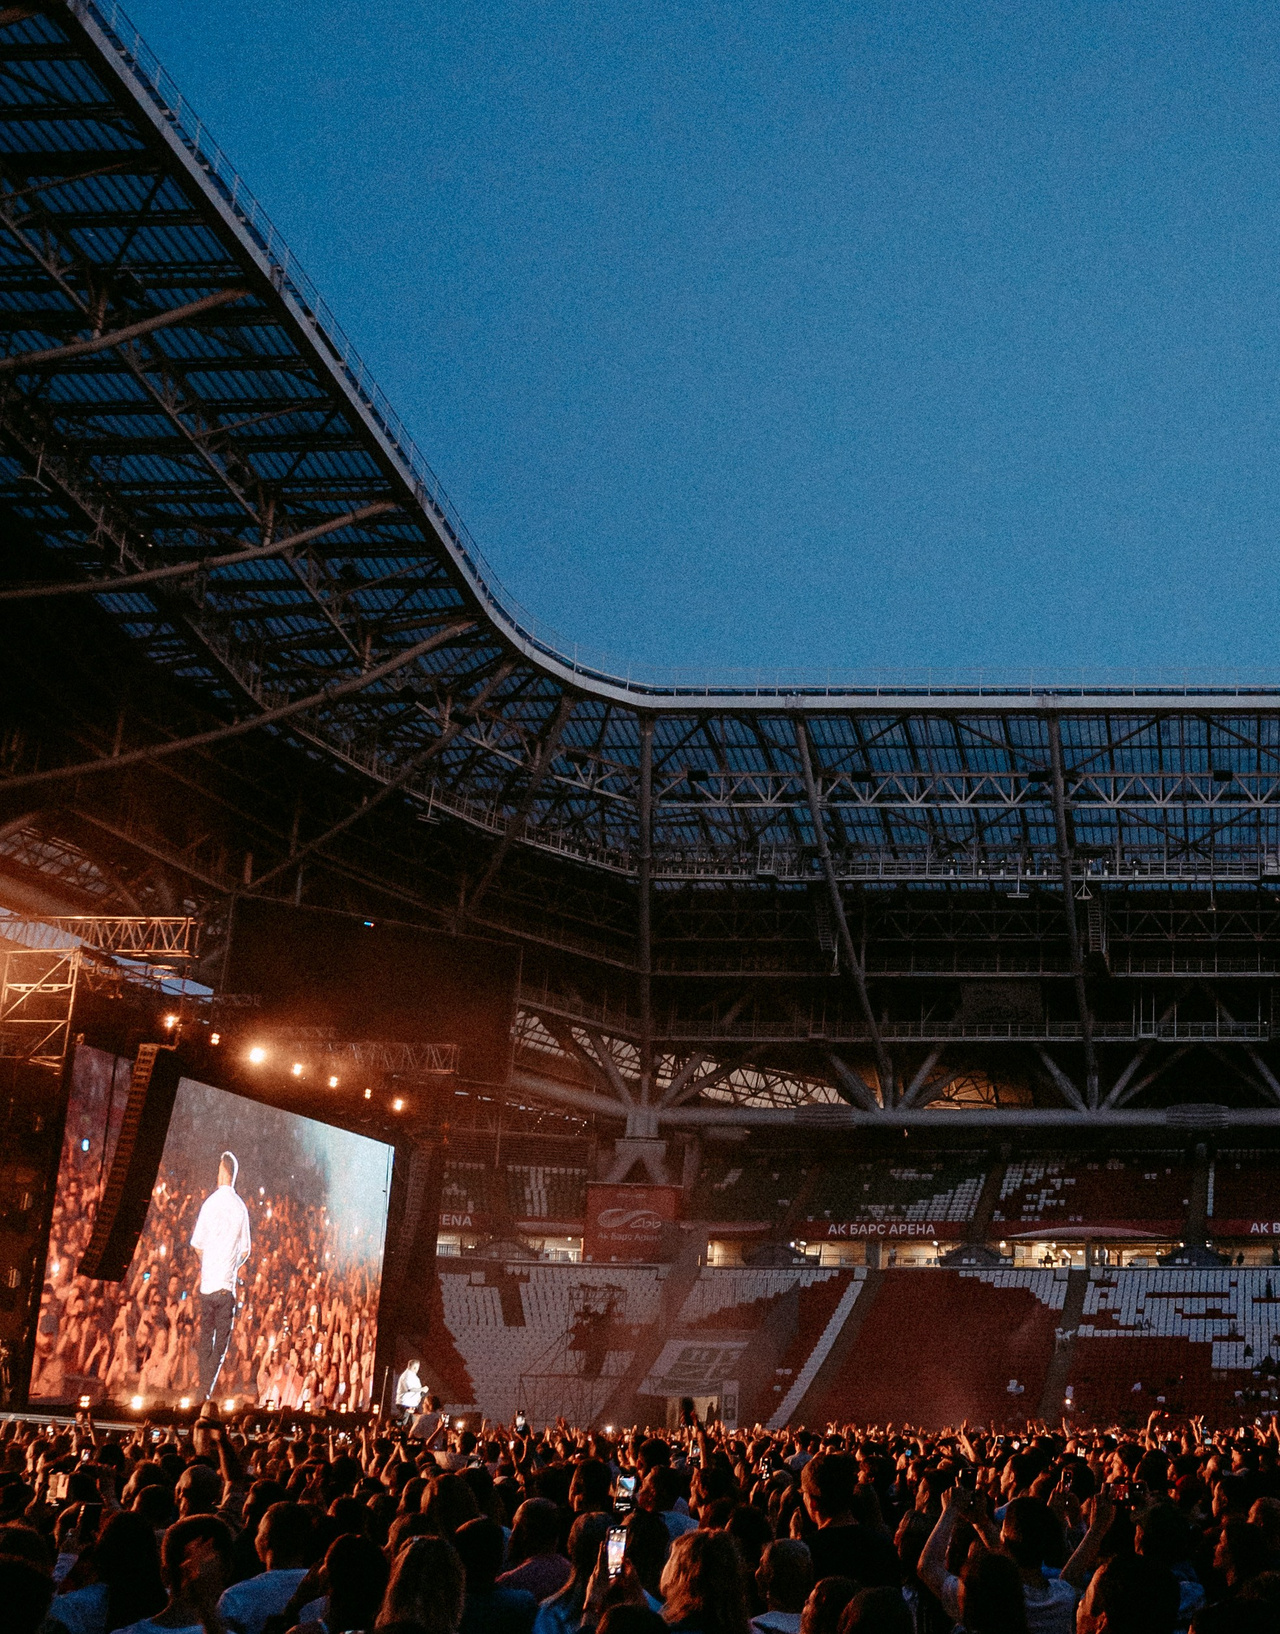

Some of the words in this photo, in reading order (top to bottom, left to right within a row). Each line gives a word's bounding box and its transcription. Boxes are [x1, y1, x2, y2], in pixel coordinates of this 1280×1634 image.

[439, 1213, 473, 1227] ENA
[828, 1223, 846, 1235] АК
[849, 1223, 886, 1235] БАРС
[889, 1223, 936, 1235] АРЕНА
[1250, 1222, 1269, 1234] AK
